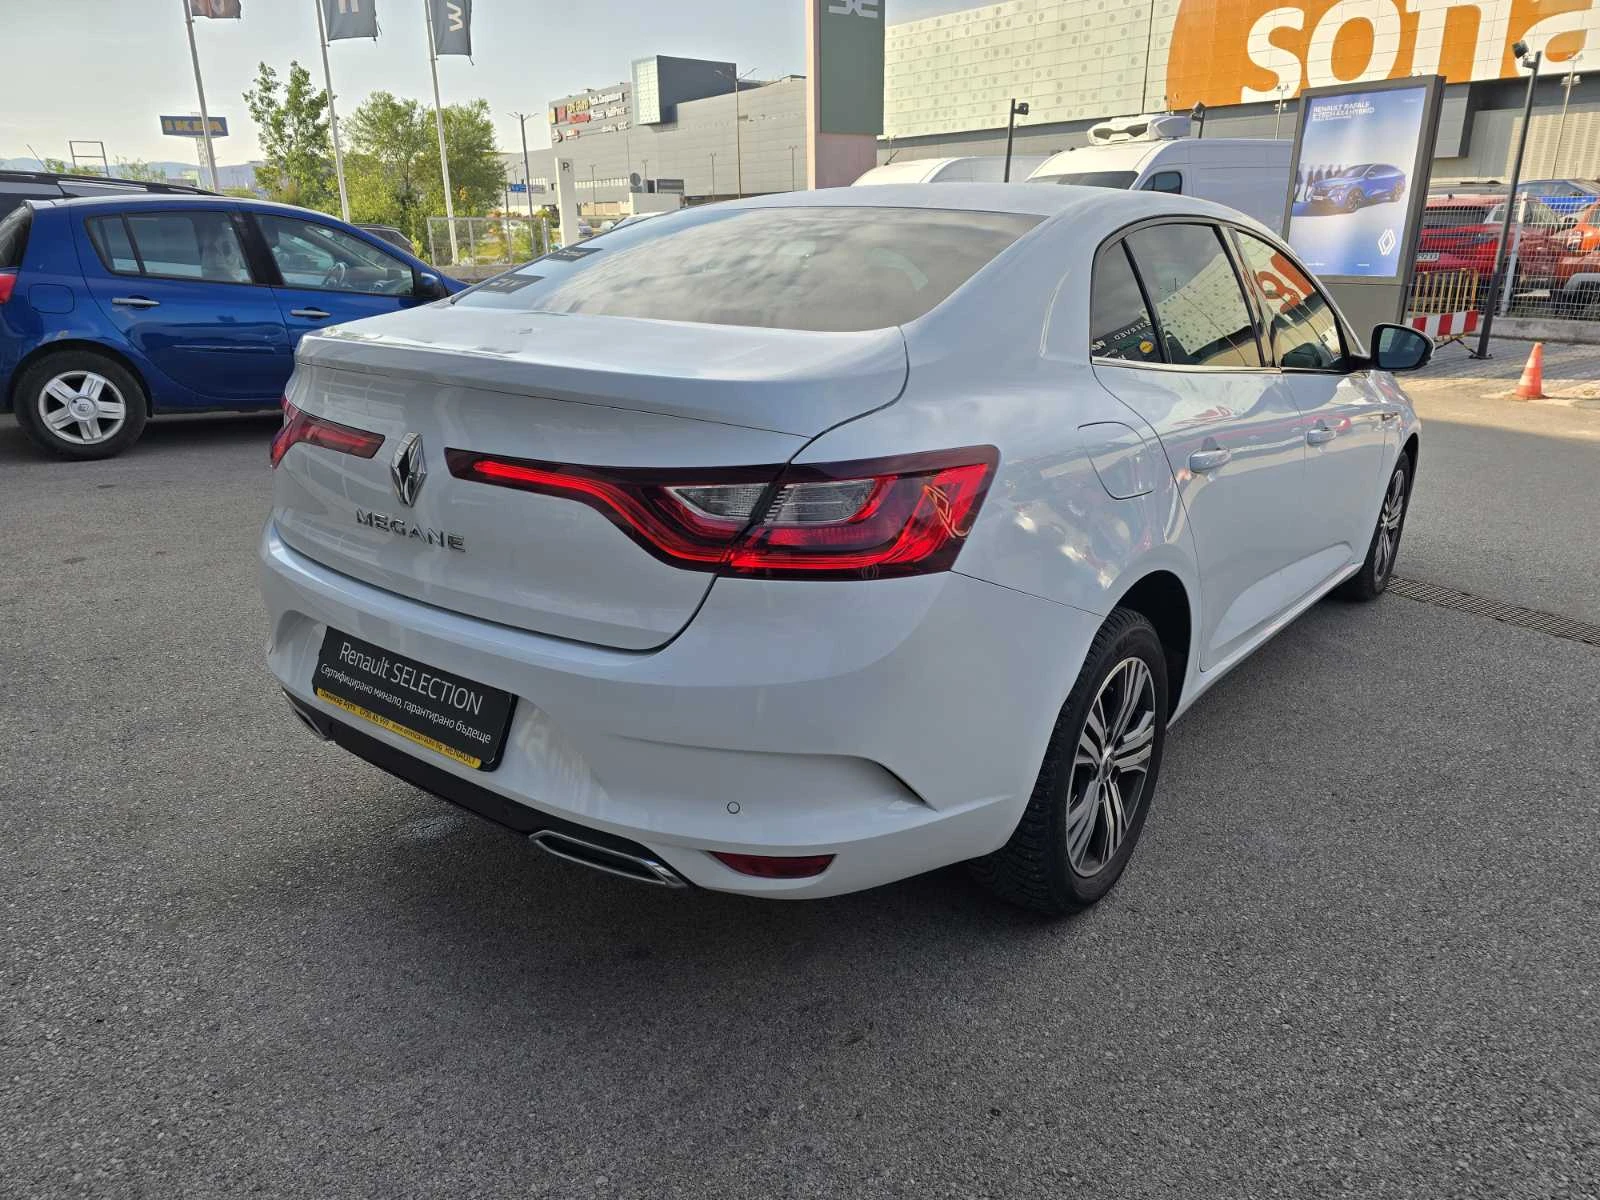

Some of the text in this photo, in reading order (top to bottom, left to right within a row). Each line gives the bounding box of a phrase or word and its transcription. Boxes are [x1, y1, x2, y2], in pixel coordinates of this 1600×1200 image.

[356, 507, 466, 553] MEGANE
[320, 663, 492, 745] Сертифицирано минало, гарантирано бъдеще
[339, 641, 484, 716] Renault SELECTION
